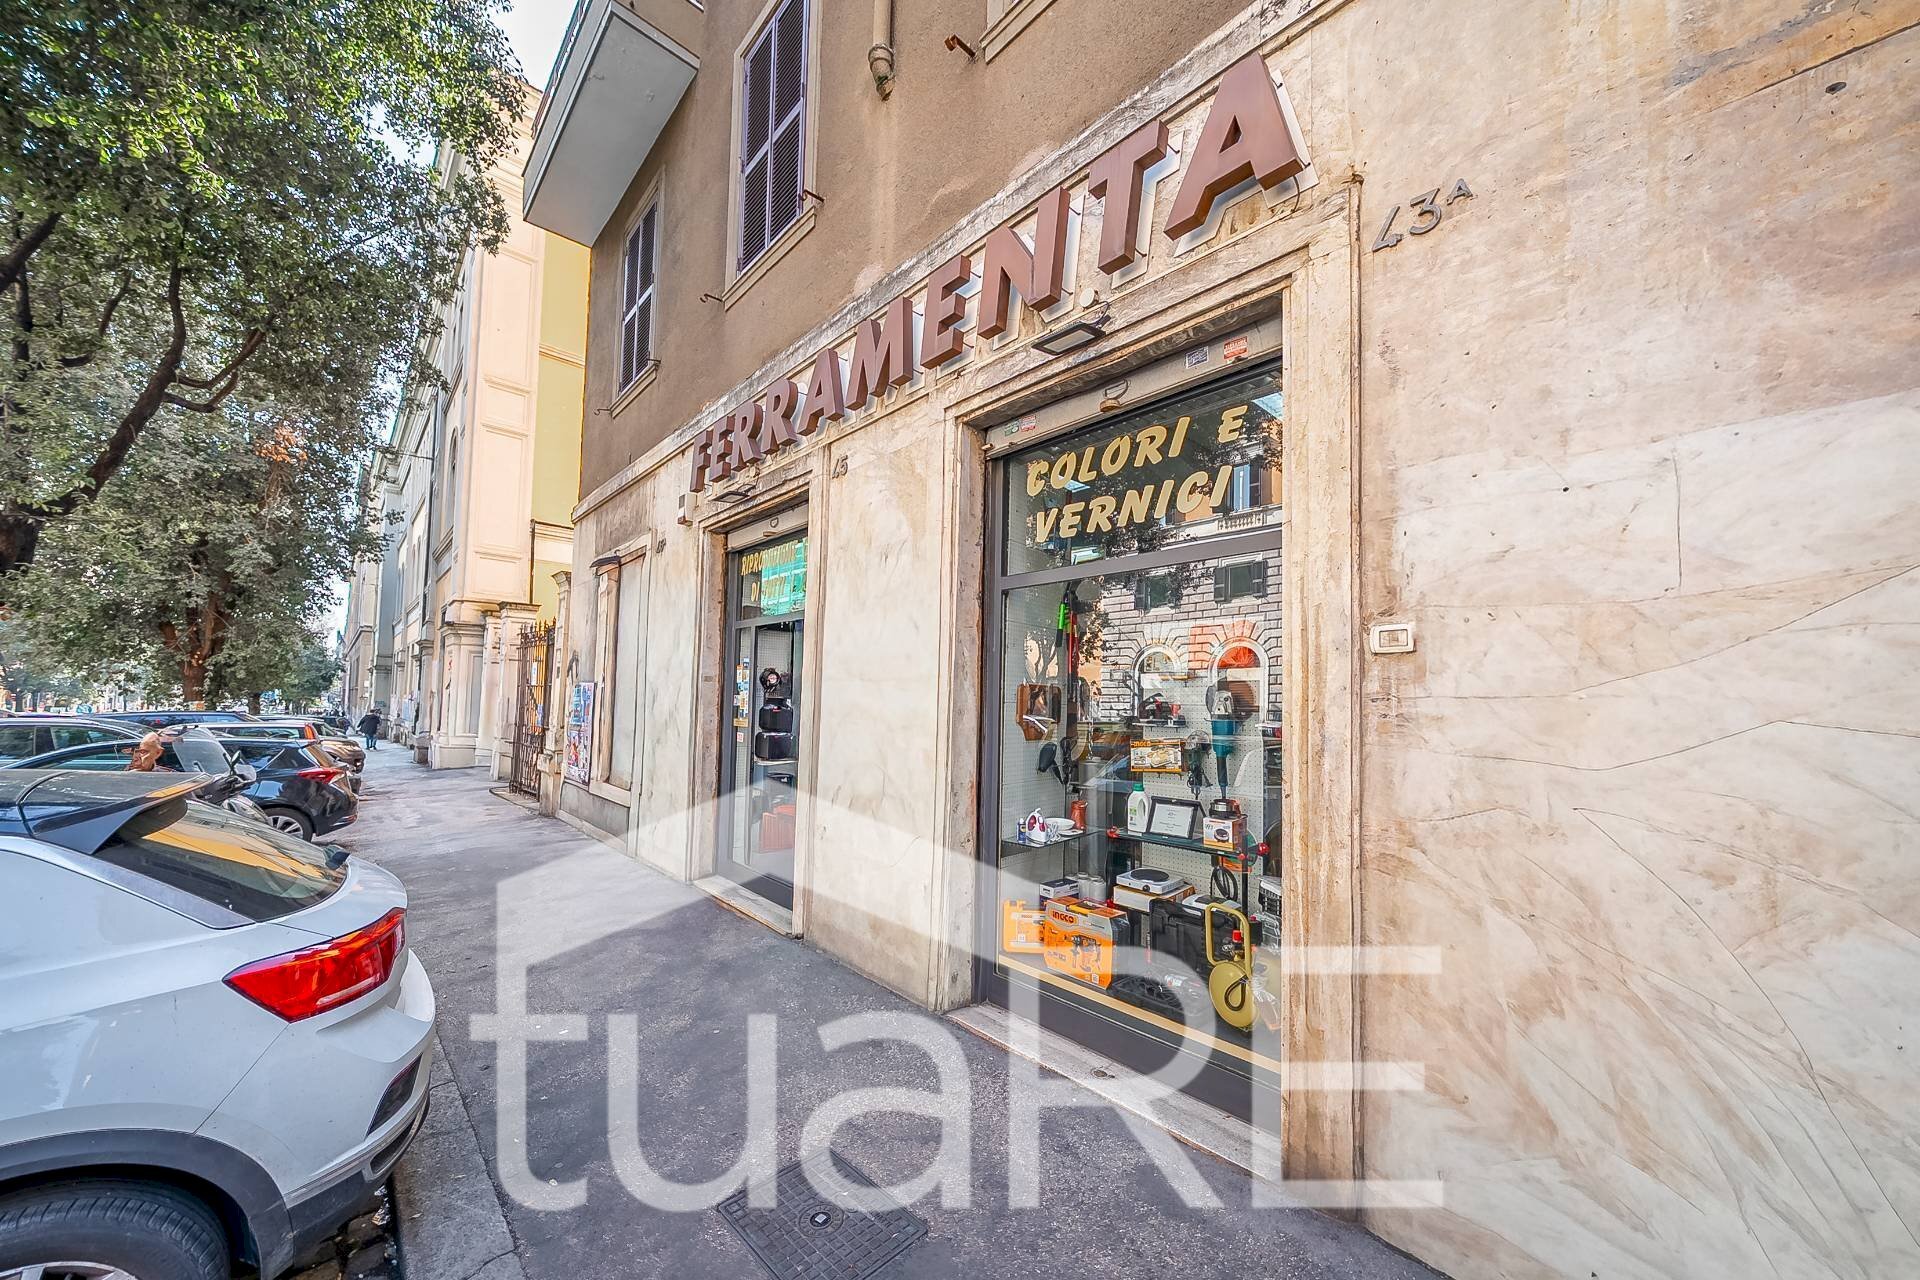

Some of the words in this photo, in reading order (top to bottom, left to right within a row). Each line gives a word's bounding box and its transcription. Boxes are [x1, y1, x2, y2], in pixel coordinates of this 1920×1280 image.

[689, 52, 1305, 494] FERRAMENTA
[1026, 416, 1191, 498] COLORI
[1217, 404, 1249, 444] E
[1034, 465, 1233, 543] VERNICI
[1052, 910, 1075, 924] INGCO
